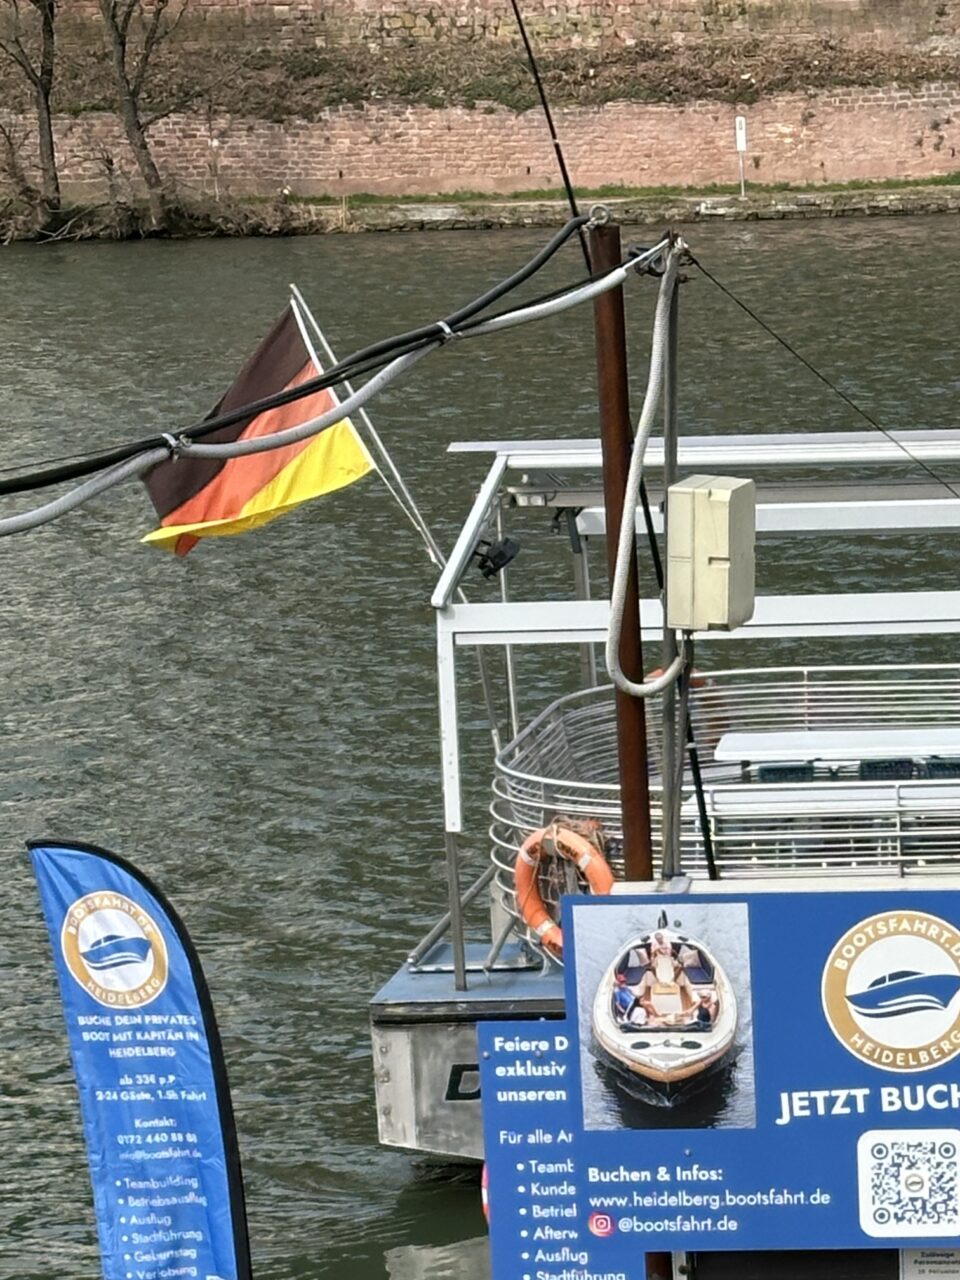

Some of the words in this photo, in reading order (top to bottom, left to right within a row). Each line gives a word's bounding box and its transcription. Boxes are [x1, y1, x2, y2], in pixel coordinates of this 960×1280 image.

[88, 978, 160, 1004] HEIDELBERG
[78, 1016, 112, 1026] BUCHE
[115, 1016, 141, 1025] DEIN
[145, 1015, 196, 1025] PRIVATES
[82, 1032, 110, 1041] BOOT
[112, 1032, 132, 1042] MIT
[136, 1029, 183, 1040] KAPITÄN
[186, 1032, 199, 1041] IN
[494, 1036, 549, 1051] Feiere
[555, 1036, 568, 1050] D
[109, 1047, 176, 1058] HEIDELBERG
[495, 1060, 566, 1076] exklusiv
[120, 1075, 132, 1085] ab
[181, 1091, 206, 1100] Fahrt
[497, 1090, 566, 1101] unseren
[776, 1088, 870, 1125] JETZT
[134, 1117, 177, 1128] Kontakt:
[117, 1134, 142, 1144] 0172
[146, 1133, 168, 1143] 440
[171, 1133, 183, 1142] 88
[500, 1131, 522, 1143] Für
[528, 1129, 552, 1143] alle
[588, 1165, 650, 1182] Buchen
[657, 1167, 670, 1181] &
[676, 1165, 723, 1181] Infos:
[124, 1176, 198, 1189] Teambuilding
[531, 1181, 576, 1195] Kunde
[589, 1189, 830, 1209] www.heidelberg.bootsfahrt.de
[130, 1213, 171, 1226] Ausflug
[618, 1215, 738, 1232] @bootsfahrt.de
[131, 1230, 202, 1244] Stadtführung
[535, 1248, 588, 1264] Ausflug
